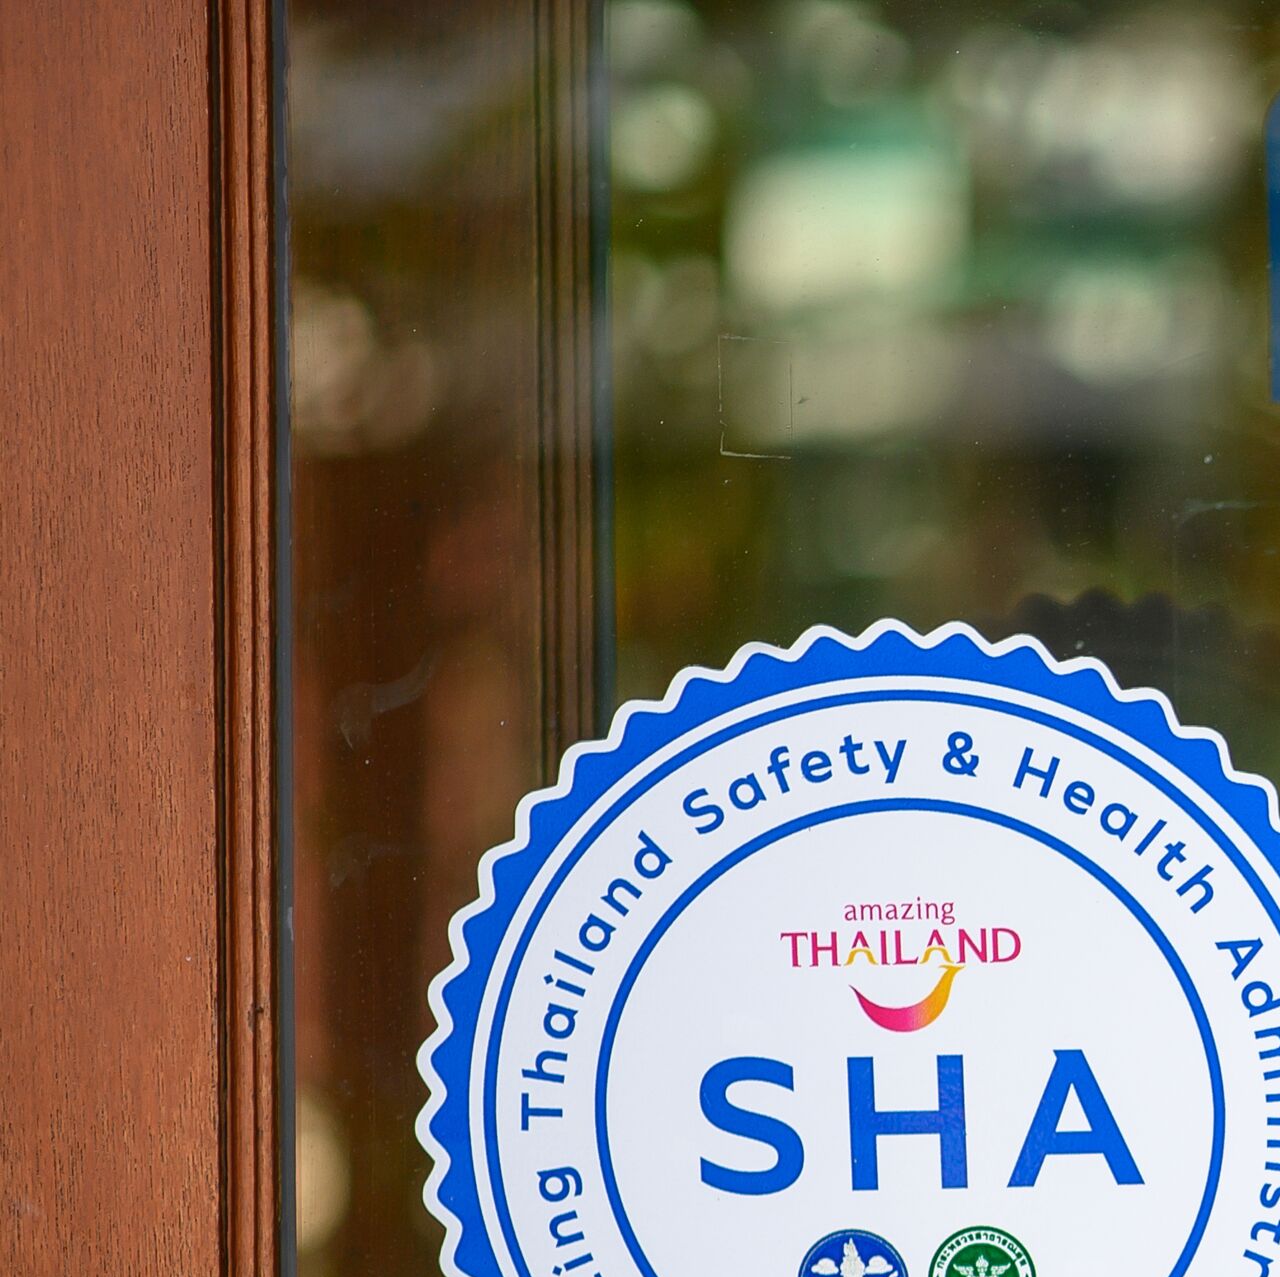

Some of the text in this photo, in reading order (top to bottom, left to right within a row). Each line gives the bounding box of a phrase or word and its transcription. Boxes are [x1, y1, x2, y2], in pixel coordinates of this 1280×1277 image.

[521, 831, 672, 1130] Thailand
[683, 736, 907, 834] Safety
[942, 731, 980, 777] &
[1013, 747, 1214, 914] Health
[780, 928, 1022, 967] THAILAND
[844, 896, 956, 925] amazing
[699, 1048, 1145, 1196] SHA
